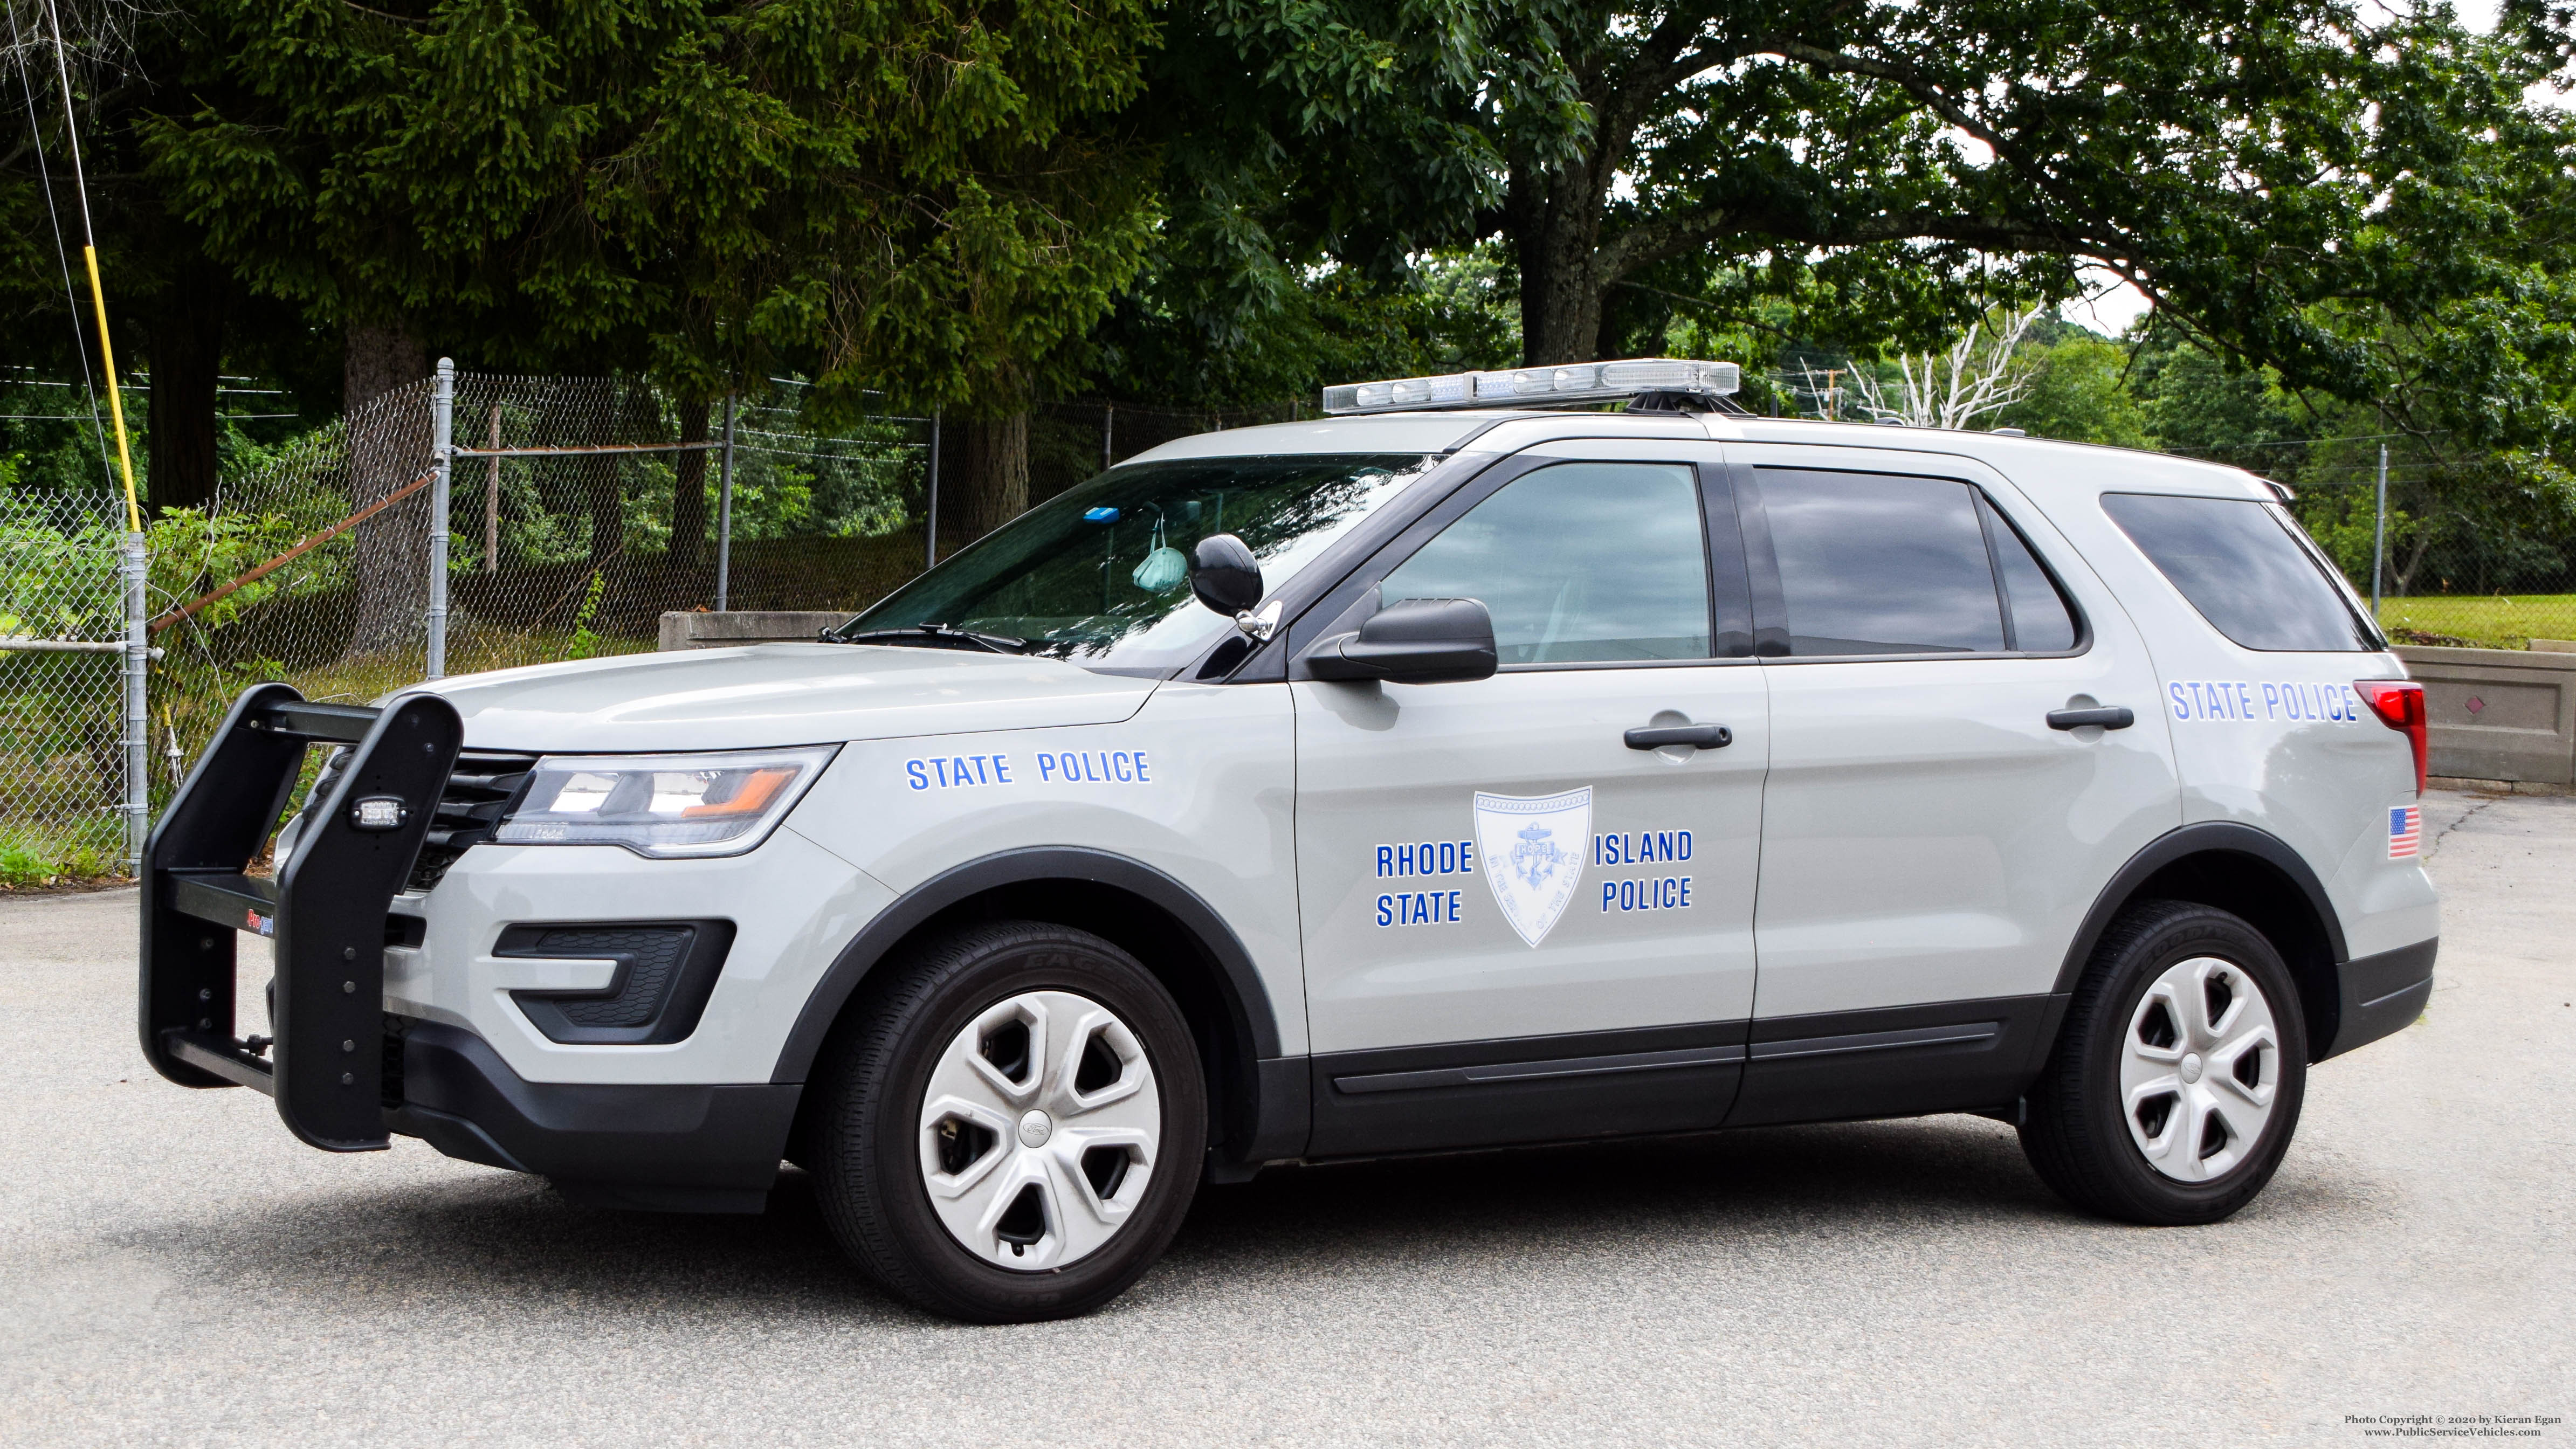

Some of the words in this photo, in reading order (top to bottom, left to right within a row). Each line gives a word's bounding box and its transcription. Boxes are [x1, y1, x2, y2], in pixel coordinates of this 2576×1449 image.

[2168, 681, 2255, 720] STATE
[2261, 682, 2357, 722] POLICE
[905, 753, 1014, 791] STATE
[1036, 750, 1151, 783] POLICE
[1375, 840, 1473, 878] RHODE
[1594, 830, 1692, 866] ISLAND
[1521, 844, 1547, 854] HOPE
[1375, 889, 1462, 928] STATE
[1601, 876, 1692, 913] POLICE
[1027, 1124, 1044, 1134] Ford
